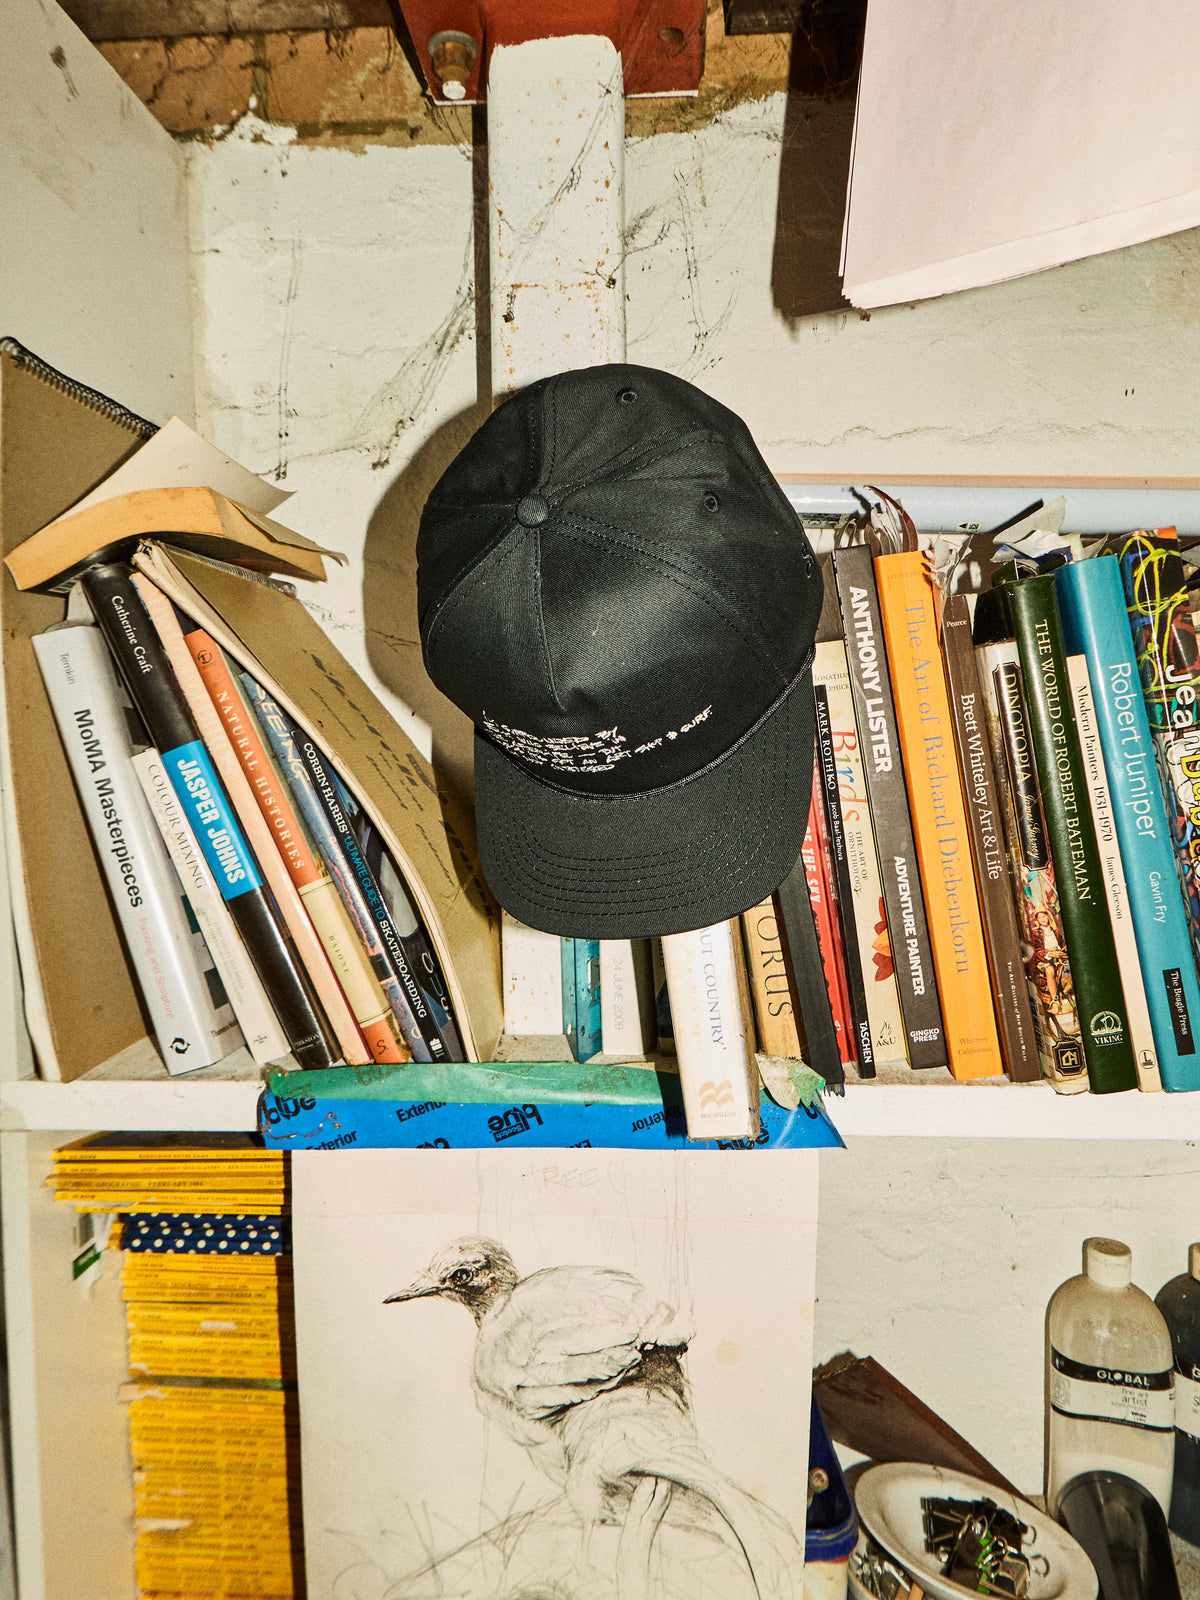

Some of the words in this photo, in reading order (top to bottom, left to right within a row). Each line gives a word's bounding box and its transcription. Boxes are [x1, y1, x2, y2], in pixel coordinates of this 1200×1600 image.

[111, 595, 138, 645] Catherine
[134, 645, 153, 675] Craft
[849, 586, 882, 693] ANTHONY
[905, 599, 926, 648] The
[946, 619, 968, 628] Pearce
[1035, 619, 1051, 656] THE
[60, 652, 76, 685] Temkin
[911, 658, 931, 696] Art
[1041, 657, 1062, 719] WORLD
[817, 701, 829, 736] MARK
[918, 702, 940, 724] of
[960, 692, 977, 733] Brett
[1108, 662, 1141, 745] Robert
[1165, 664, 1200, 751] Jean
[865, 698, 893, 773] LISTER
[1003, 672, 1032, 783] DINOTOPIA
[1051, 721, 1067, 745] OF
[217, 691, 256, 771] NATURAL
[255, 776, 305, 870] HISTORIES
[303, 742, 331, 790] CORBIN
[822, 740, 836, 790] ROTHKO
[832, 731, 868, 822] Birds
[923, 735, 955, 829] Richard
[967, 733, 989, 810] Whiteley
[1054, 746, 1078, 814] ROBERT
[1075, 684, 1090, 732] Modern
[1084, 735, 1100, 782] Painters
[1094, 786, 1113, 842] 1931-1970
[74, 708, 106, 774] MoMA
[95, 777, 143, 908] Masterpieces
[322, 788, 350, 834] HARRIS'
[829, 801, 839, 820] Jacob
[1124, 751, 1156, 839] Juniper
[148, 763, 182, 829] COLOUR
[175, 830, 207, 889] MIXING
[177, 758, 220, 824] JASPER
[207, 828, 246, 884] JOHNS
[833, 820, 843, 861] Baal-Teshuva
[978, 808, 994, 834] Art
[1017, 790, 1037, 824] James
[1027, 822, 1042, 861] Gurney
[344, 835, 368, 881] ULTIMATE
[801, 848, 817, 872] THE
[847, 831, 863, 893] ORNITHOLOGY
[857, 849, 866, 868] ART
[983, 835, 997, 849] &
[1066, 817, 1091, 900] BATEMAN
[985, 850, 1002, 880] Life
[1106, 855, 1115, 883] James
[362, 877, 380, 908] GUIDE
[806, 878, 821, 903] SKY
[938, 837, 970, 974] Diebenkorn
[1110, 884, 1122, 920] Gleeson
[1149, 871, 1163, 904] Gavin
[374, 903, 386, 920] TO
[893, 855, 917, 937] ADVENTURE
[906, 938, 926, 996] PAINTER
[1153, 905, 1168, 923] Fry
[379, 919, 428, 1019] SKATEBOARDING
[1169, 970, 1181, 986] The
[156, 975, 174, 1019] Sculpture
[1171, 987, 1187, 1013] Beagle
[859, 1020, 873, 1064] TASCHEN
[876, 1037, 896, 1047] A&U
[909, 1027, 940, 1038] GINGKO
[913, 1034, 938, 1043] PRESS
[1094, 1034, 1123, 1045] VIKING
[1178, 1014, 1190, 1035] Press
[487, 1103, 544, 1131] blue
[631, 1105, 682, 1132] Exterior
